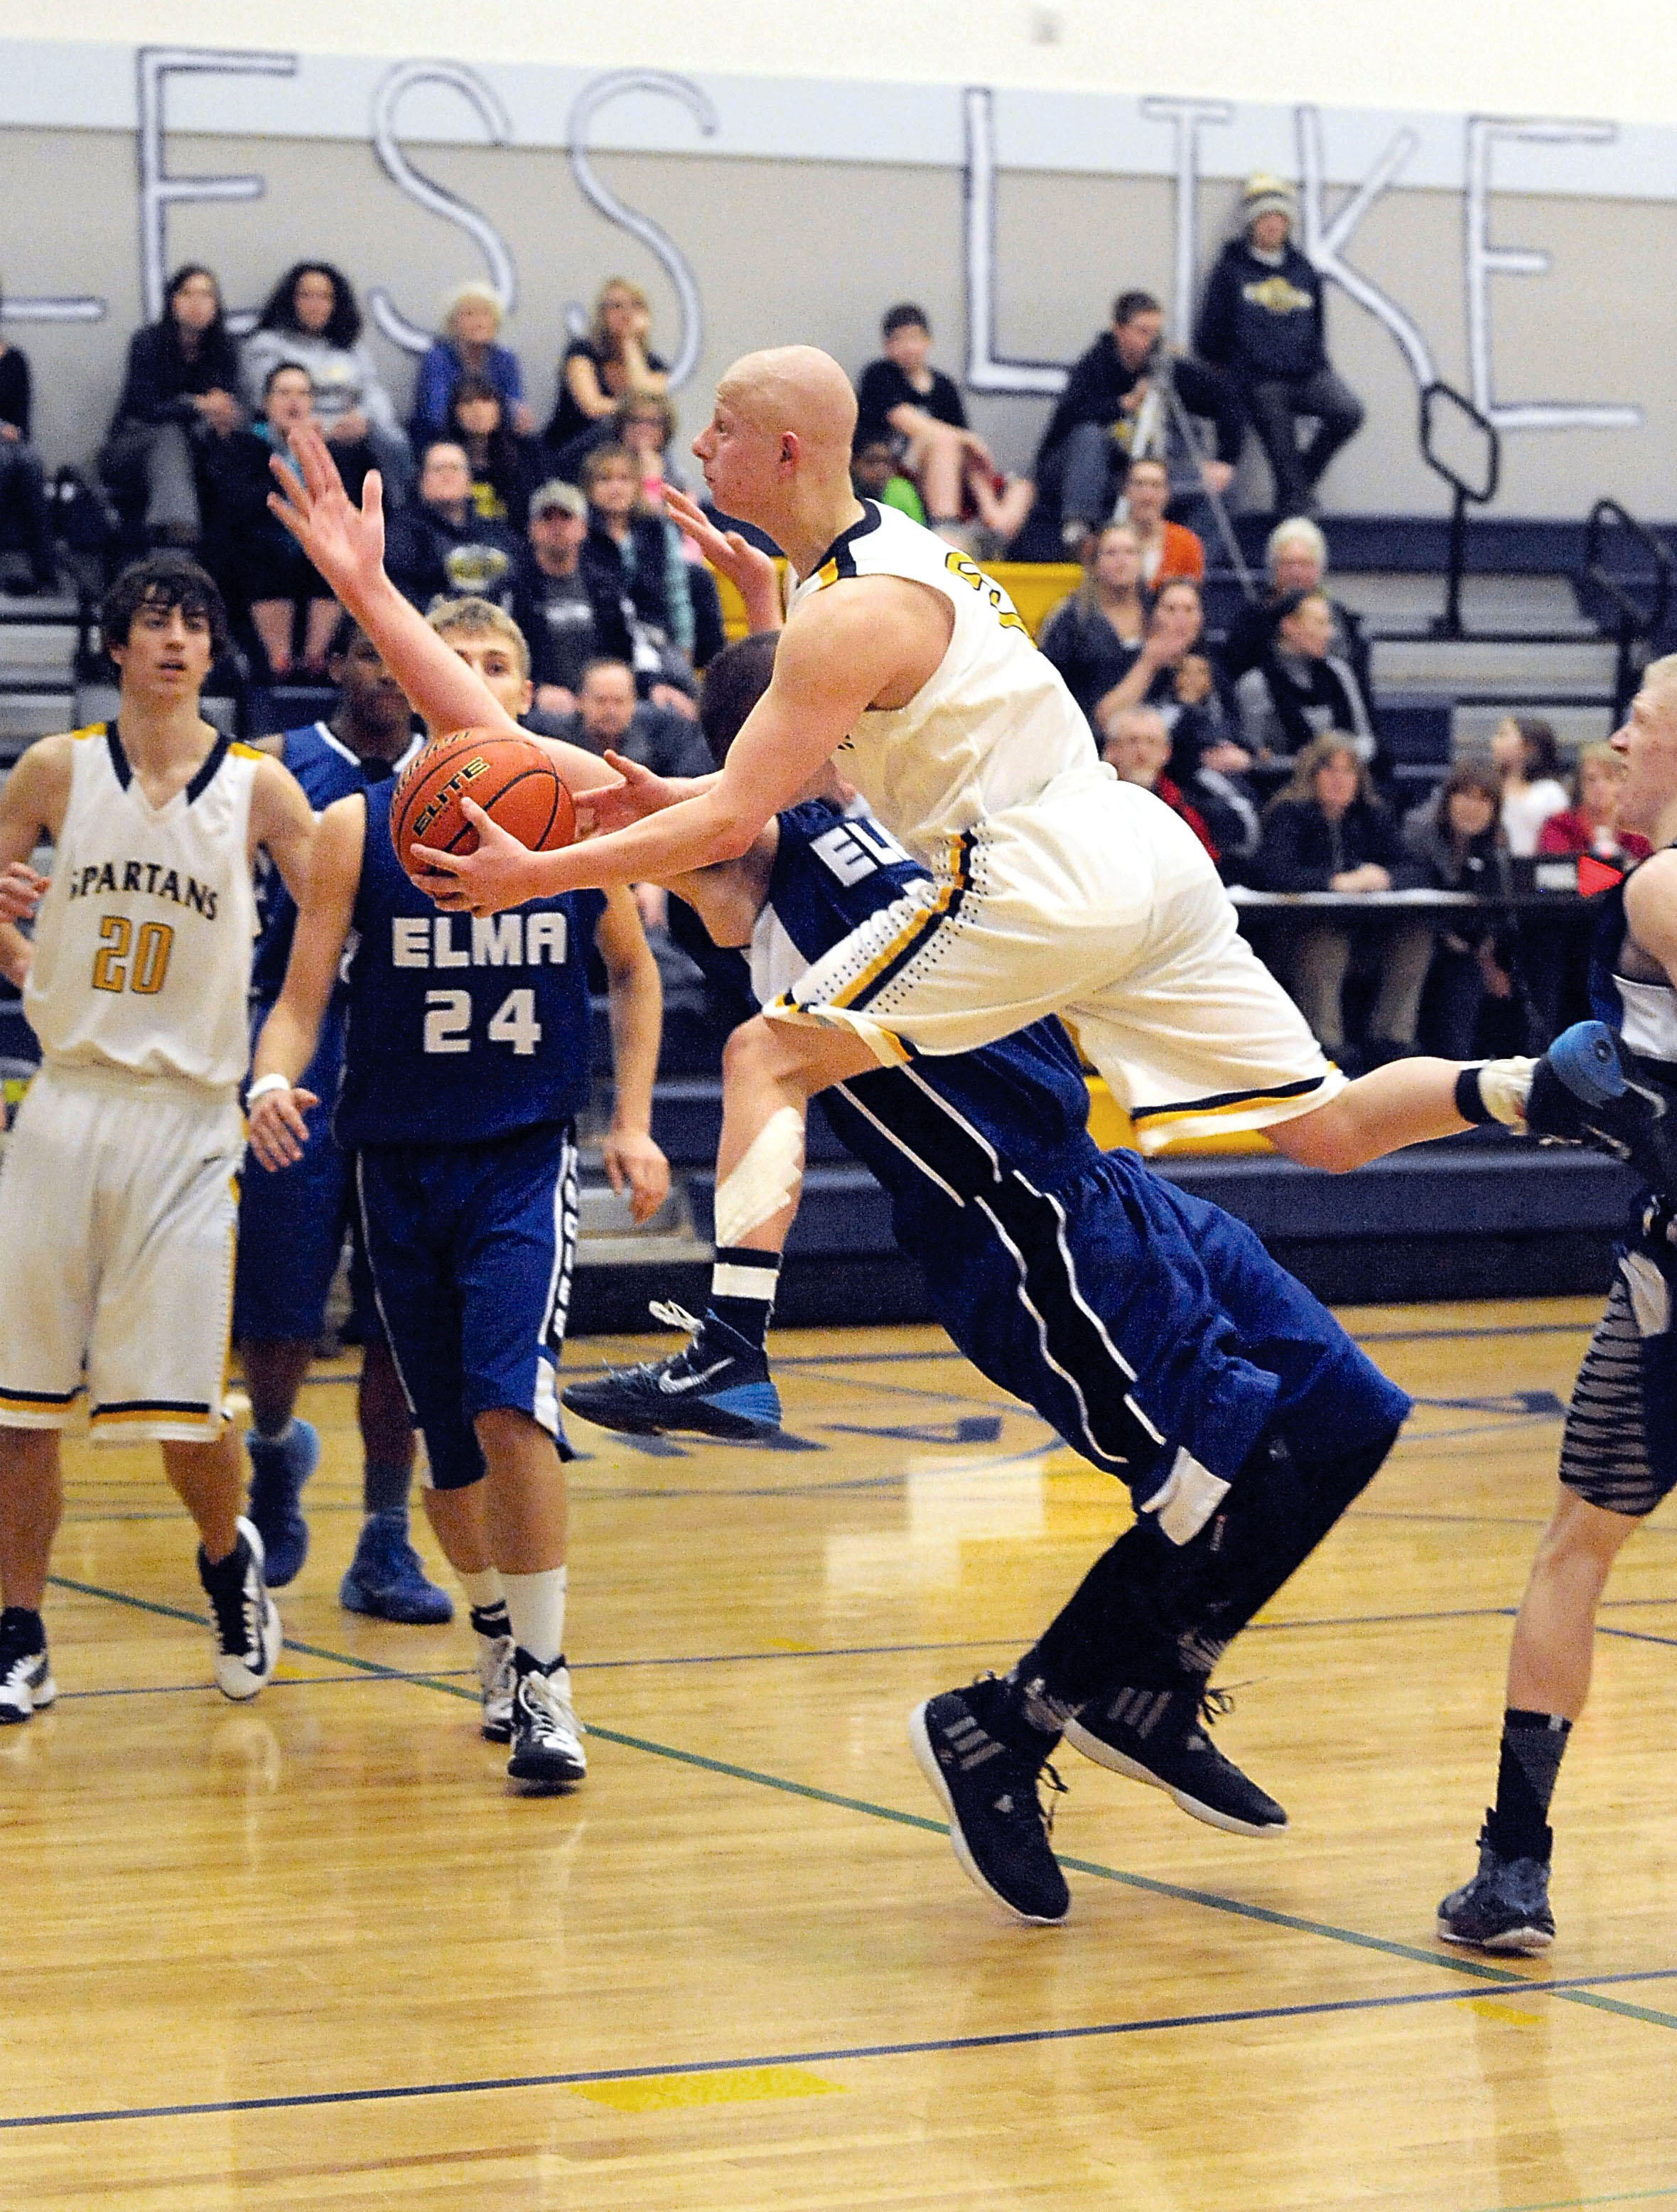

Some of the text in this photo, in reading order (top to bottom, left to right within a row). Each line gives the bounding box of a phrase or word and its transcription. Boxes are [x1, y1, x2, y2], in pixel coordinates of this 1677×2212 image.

[0, 47, 719, 391] ESS
[412, 756, 490, 837] ELITE
[92, 914, 174, 994] 20
[392, 912, 566, 968] ELMA
[424, 988, 541, 1055] 24
